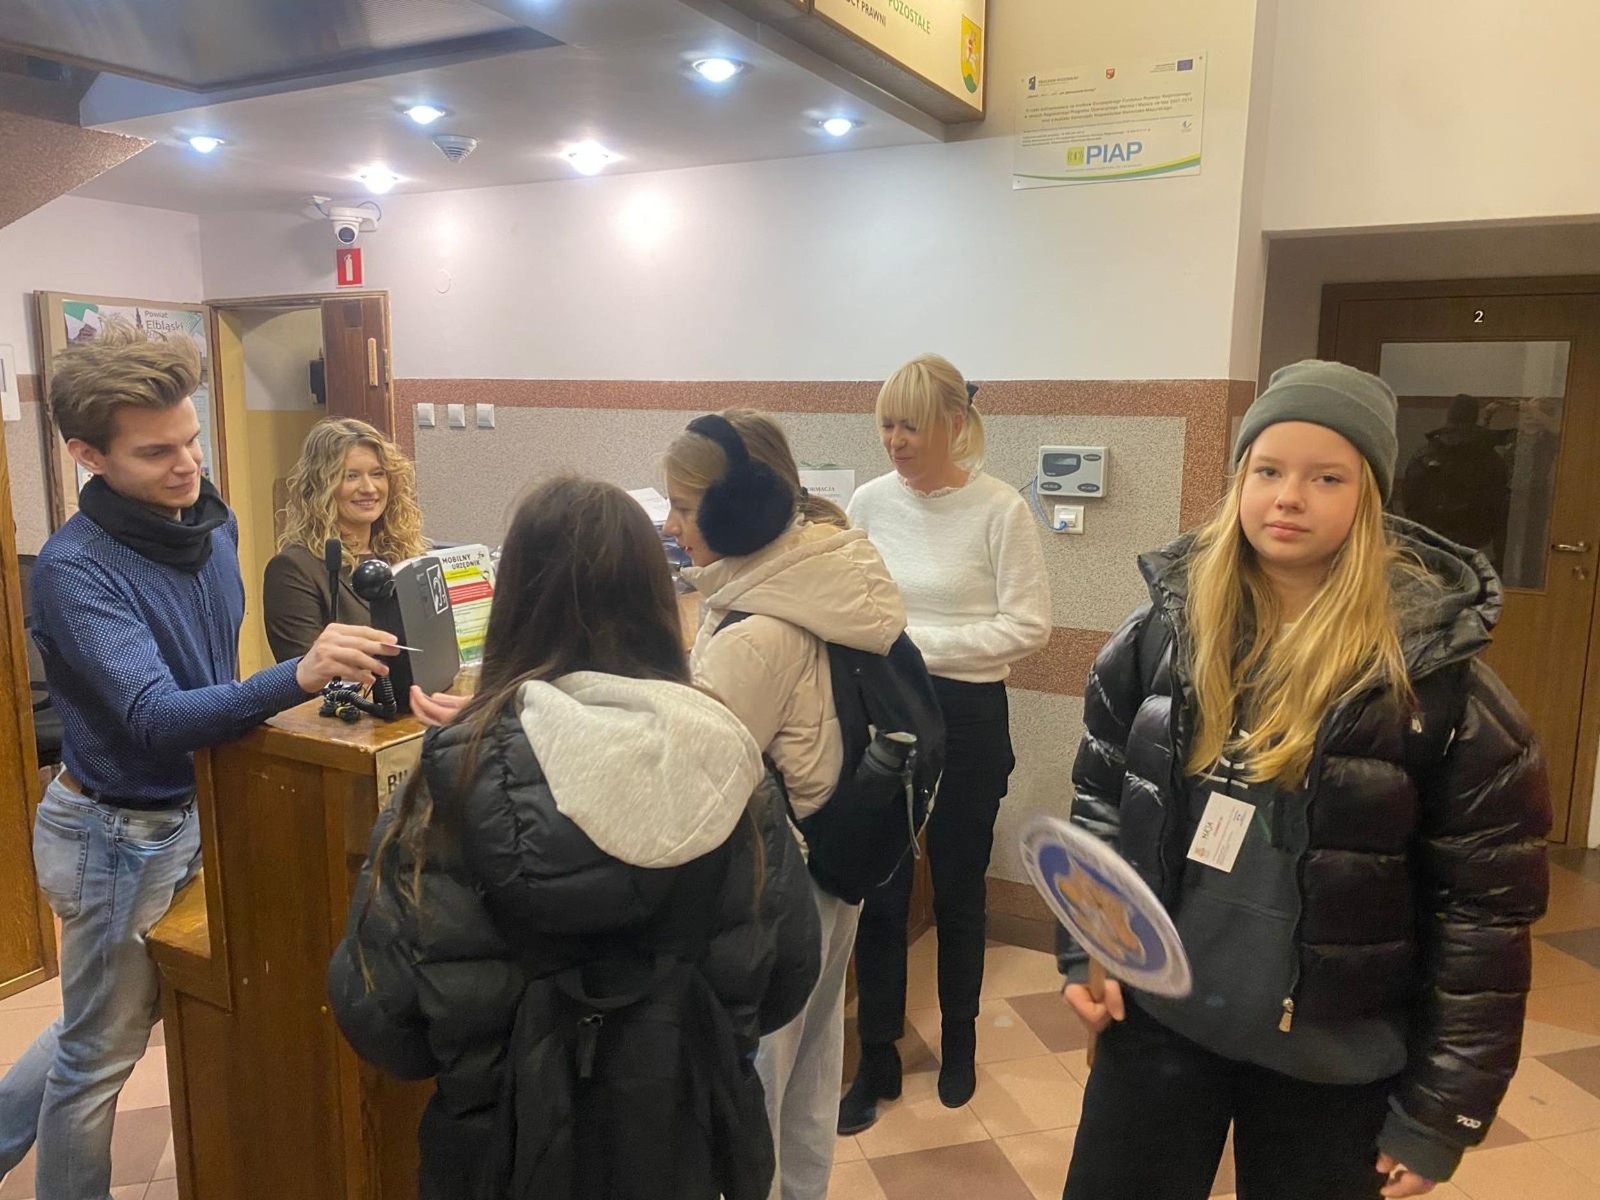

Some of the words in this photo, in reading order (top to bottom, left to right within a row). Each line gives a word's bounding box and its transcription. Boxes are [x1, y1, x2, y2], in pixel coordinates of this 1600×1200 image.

[861, 1, 886, 27] PRAWNI
[1086, 141, 1143, 164] PIAP
[144, 310, 168, 319] Powiat
[1474, 310, 1484, 323] 2
[146, 319, 184, 332] Elbląski
[442, 554, 471, 565] MOBILNY
[452, 560, 481, 571] URZĘDNIK
